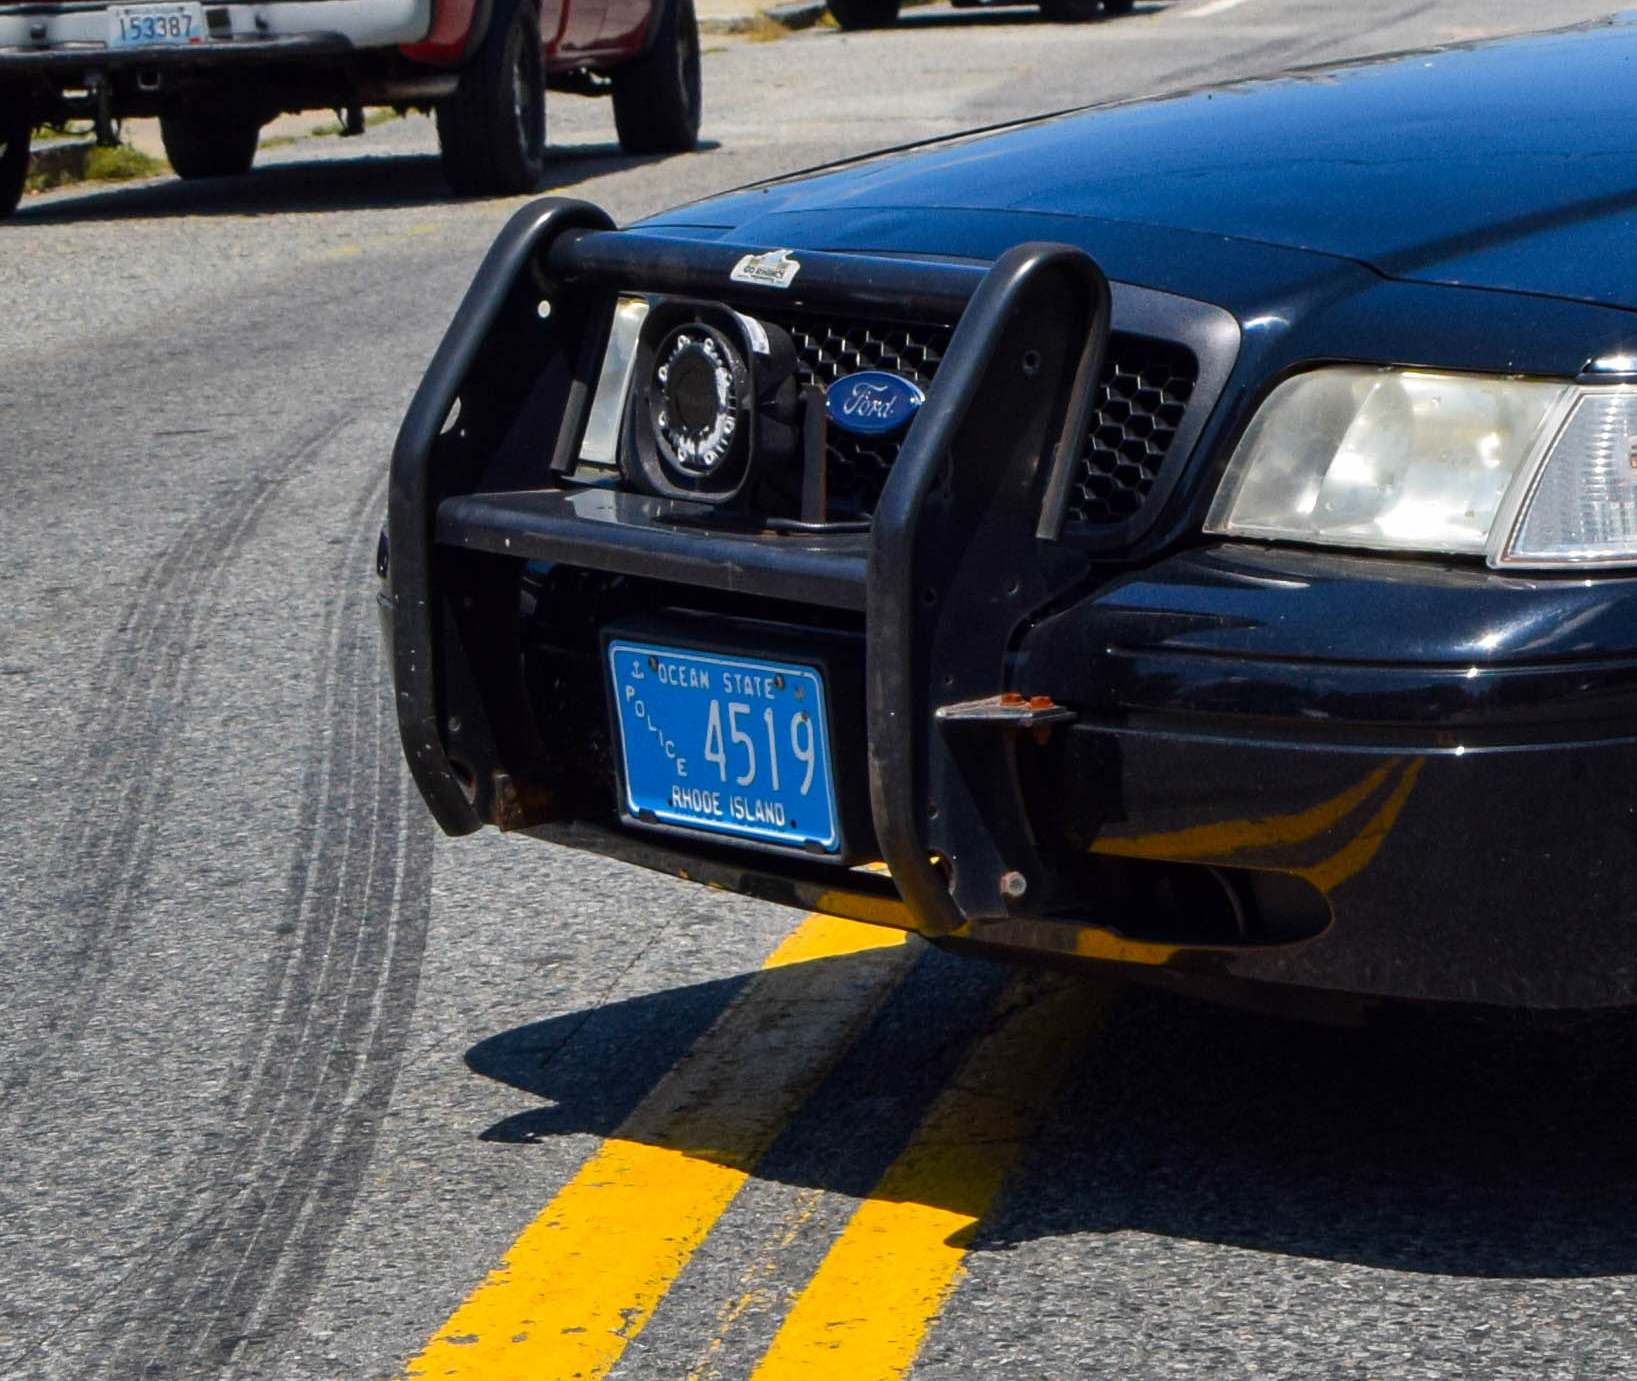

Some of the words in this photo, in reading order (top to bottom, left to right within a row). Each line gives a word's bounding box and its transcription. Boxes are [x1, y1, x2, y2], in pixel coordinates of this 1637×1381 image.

[120, 15, 192, 40] 153387
[843, 382, 898, 419] Ford
[657, 663, 709, 689] OCEAN
[723, 672, 775, 700] STATE
[625, 685, 688, 777] POLICE
[704, 699, 815, 796] 4519
[671, 785, 724, 816] RHODE
[729, 794, 786, 827] ISLAND
